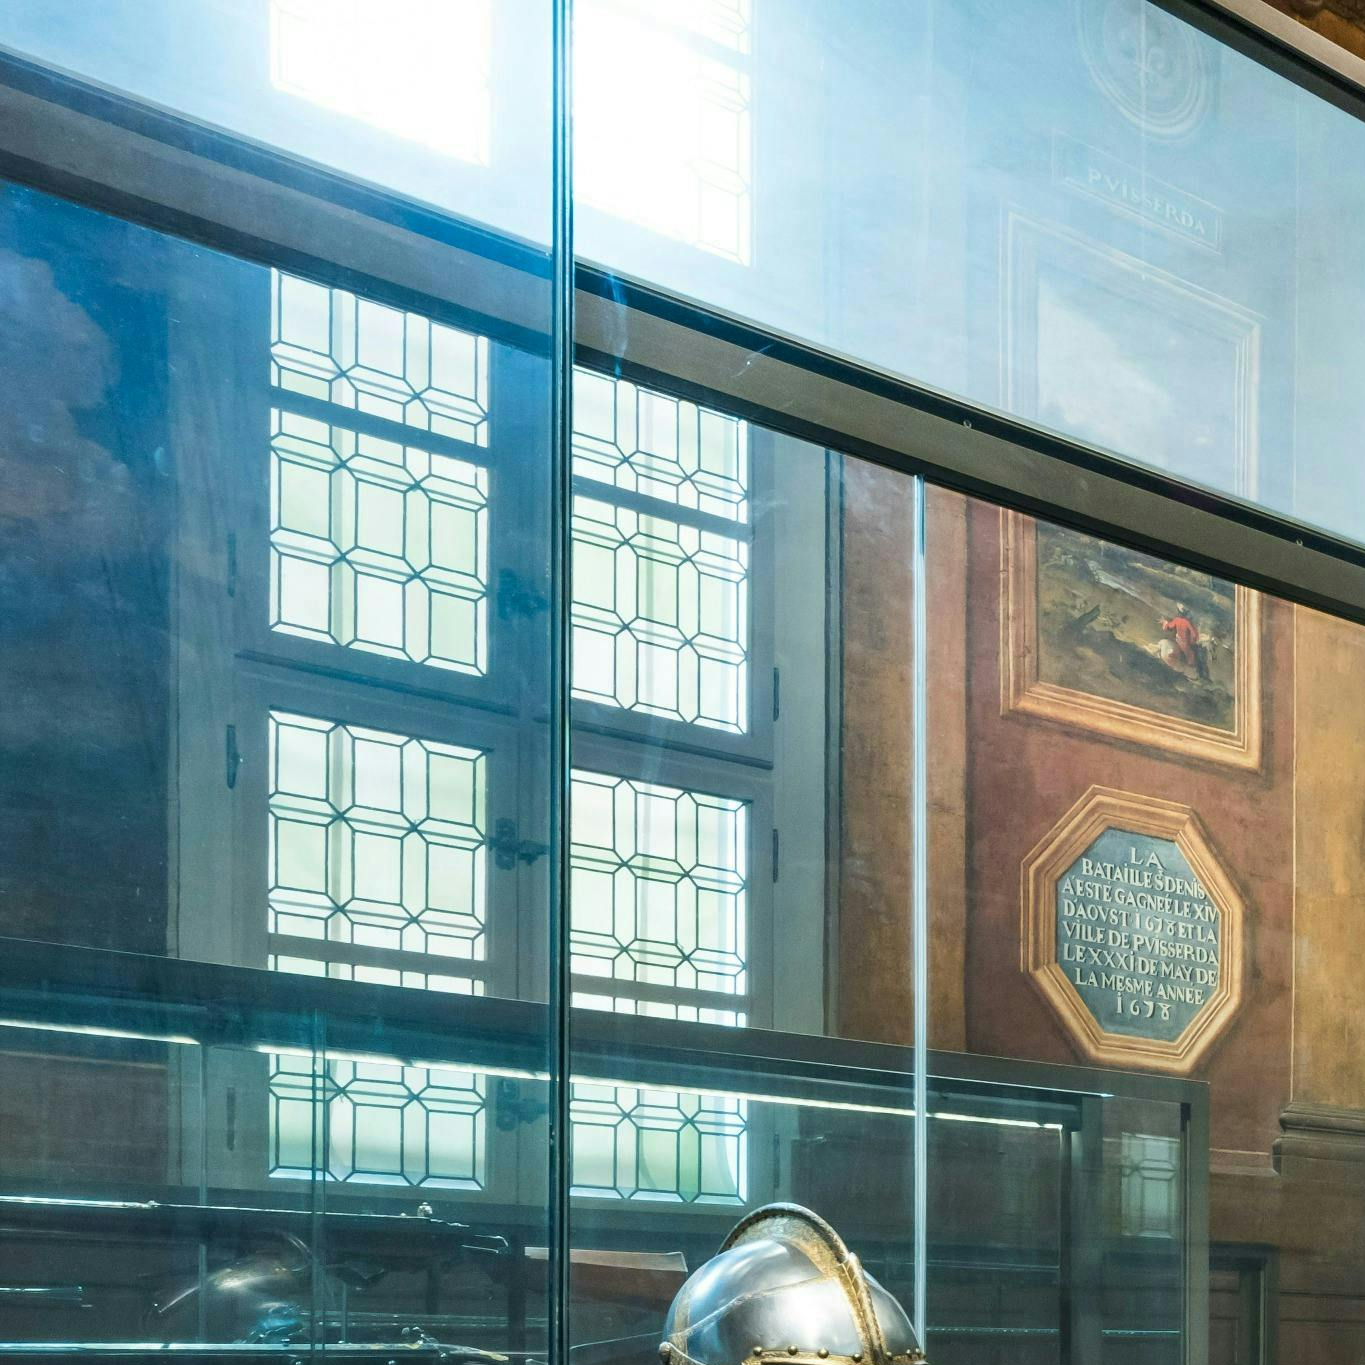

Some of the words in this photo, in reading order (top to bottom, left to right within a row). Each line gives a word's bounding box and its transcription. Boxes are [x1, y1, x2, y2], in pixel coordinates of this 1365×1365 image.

[1131, 847, 1164, 871] LA
[1174, 900, 1191, 918] LE
[1193, 901, 1218, 923] XIV
[1063, 919, 1105, 944] VILLE
[1108, 929, 1130, 948] DE
[1133, 933, 1218, 966] PVISSERDA
[1179, 921, 1194, 940] ET
[1197, 925, 1217, 944] LA
[1063, 943, 1086, 963] LE
[1088, 947, 1134, 972] XXXI
[1137, 957, 1158, 976] DE
[1160, 960, 1193, 982] MAY
[1195, 967, 1217, 986] DE
[1075, 967, 1099, 988] LA
[1101, 972, 1153, 997] MESME
